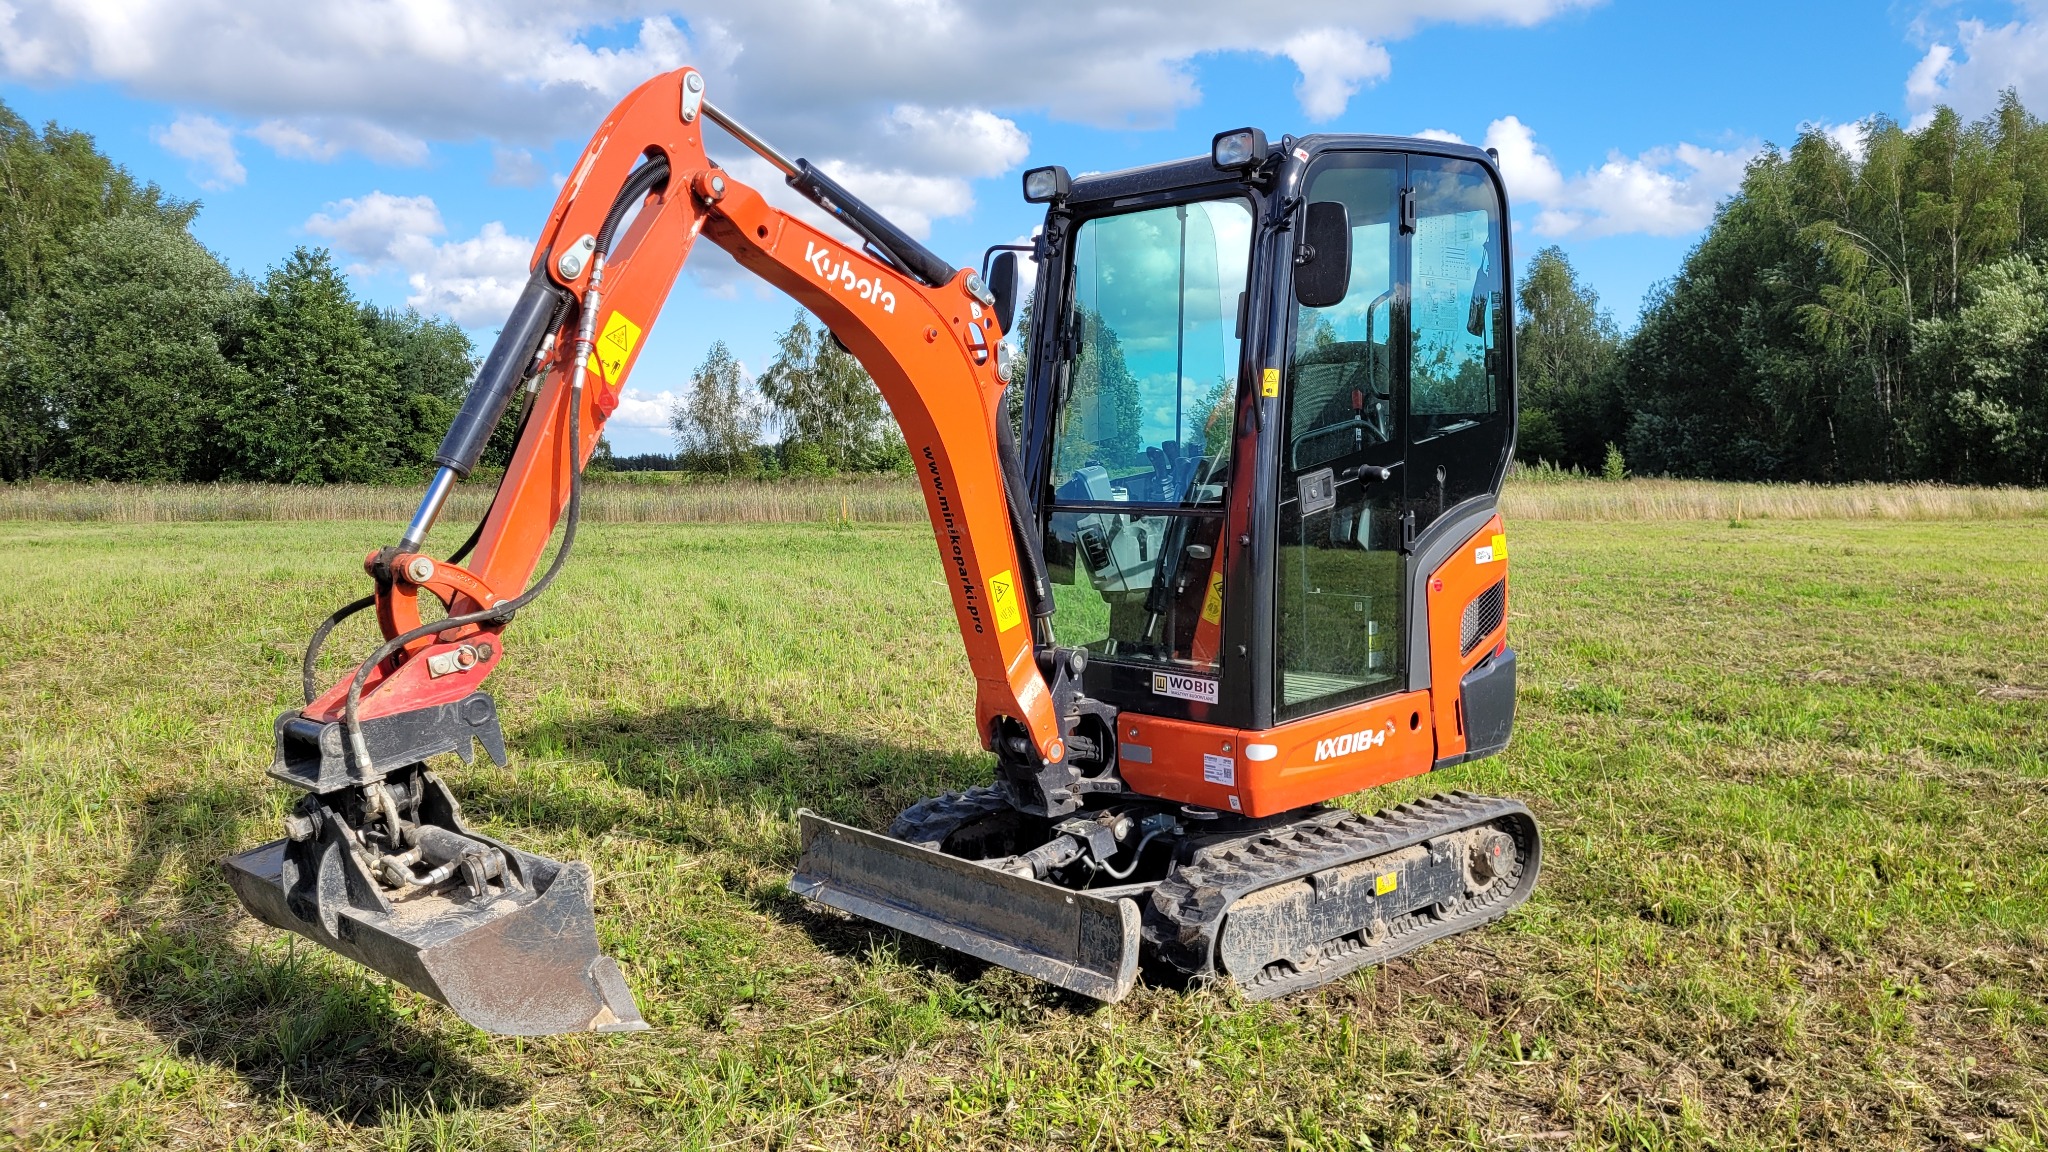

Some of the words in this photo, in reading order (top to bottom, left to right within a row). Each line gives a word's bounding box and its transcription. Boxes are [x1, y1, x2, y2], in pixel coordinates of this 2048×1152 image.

[805, 241, 896, 314] Kubota
[923, 446, 984, 634] www.minikoparki.pro
[1169, 676, 1215, 695] WOBIS
[1314, 729, 1385, 762] KX018-4
